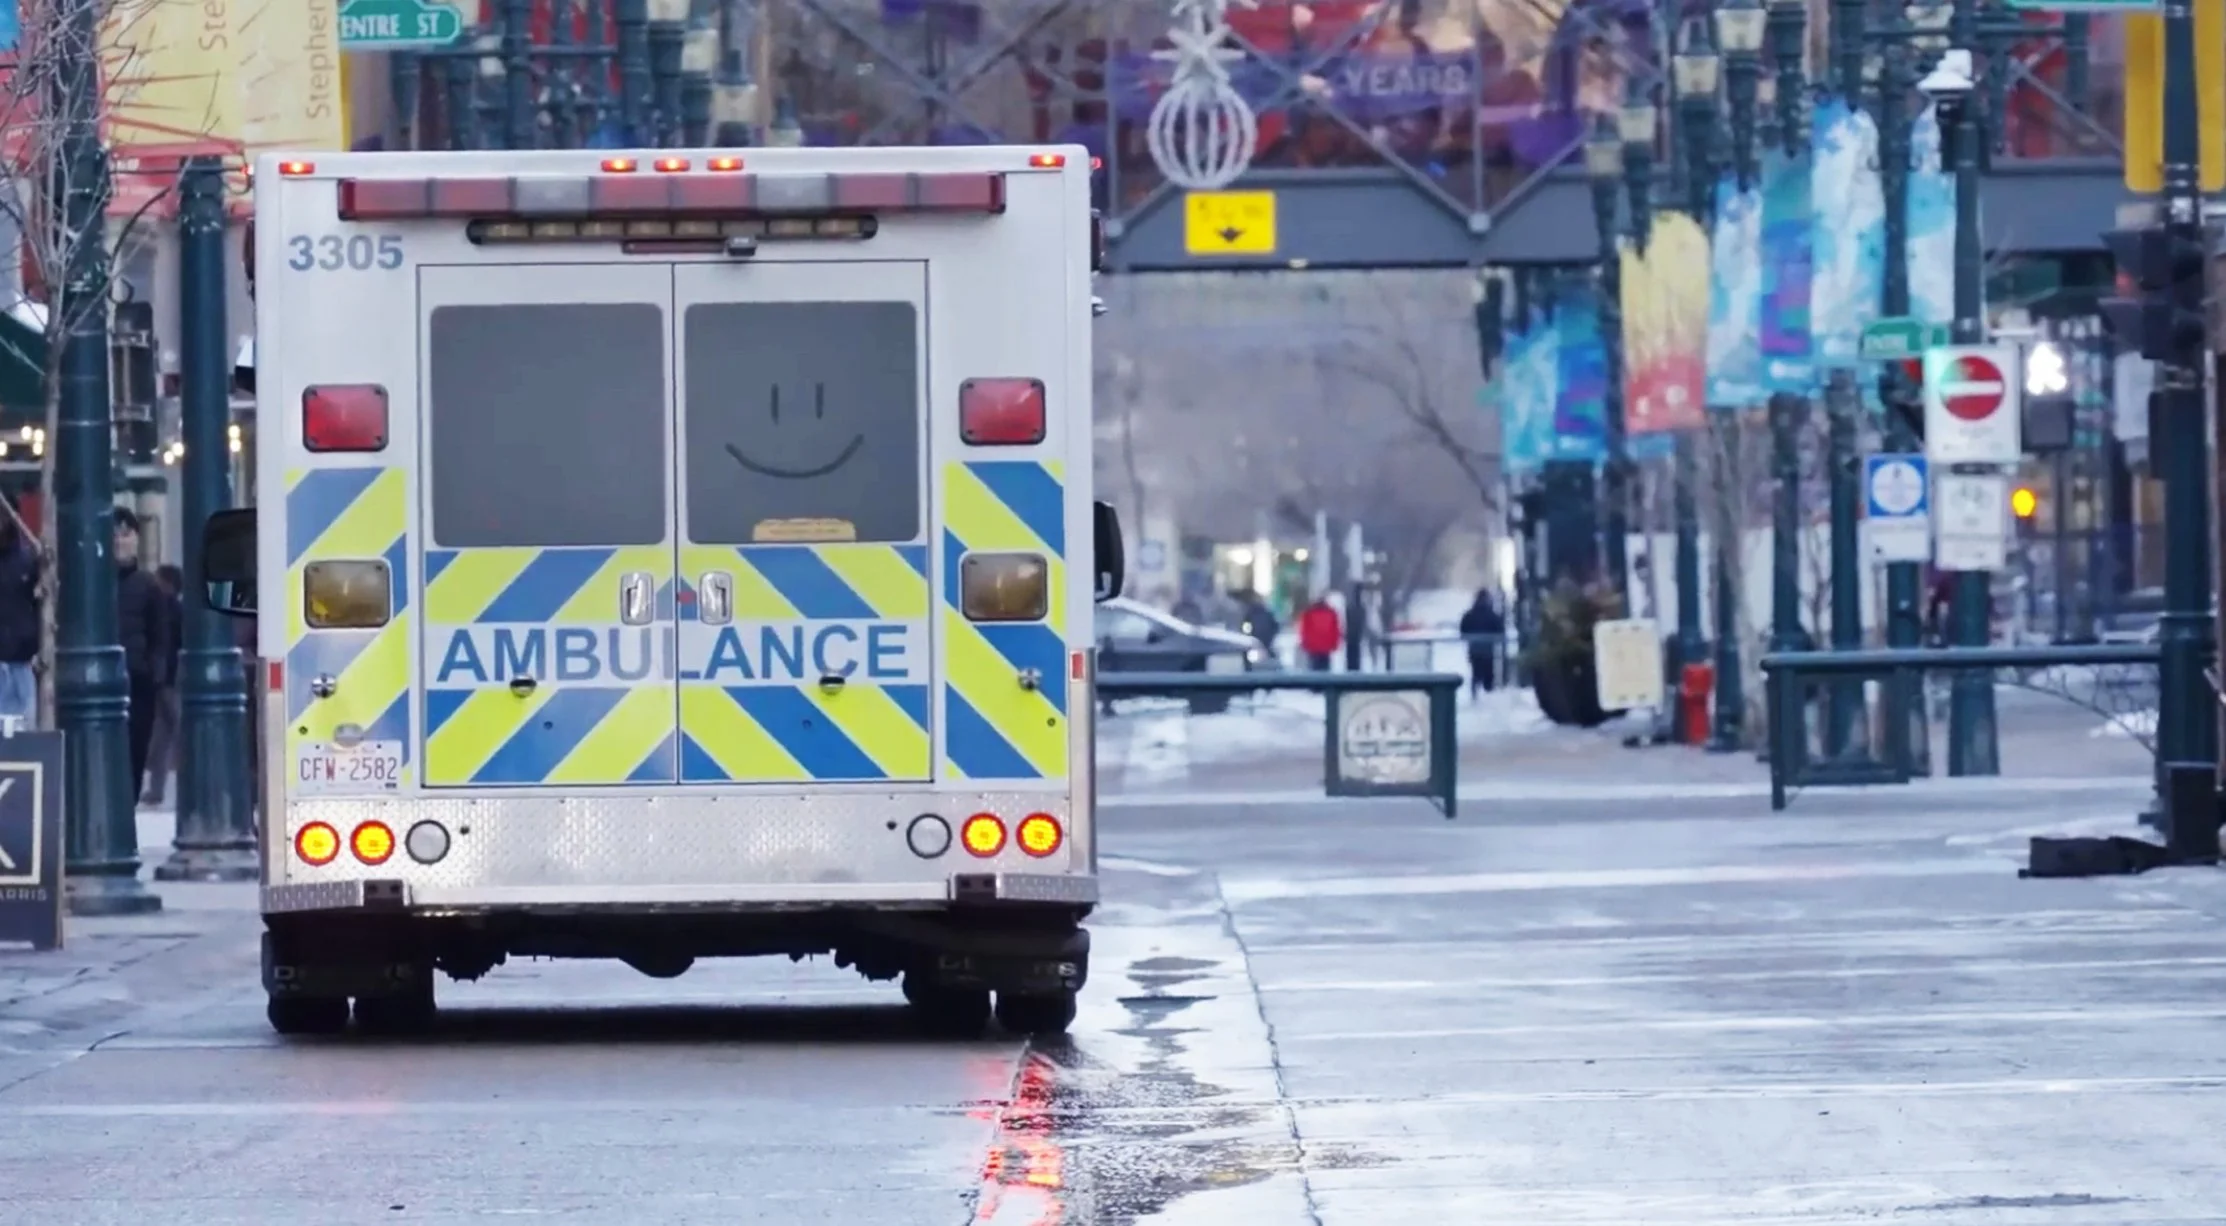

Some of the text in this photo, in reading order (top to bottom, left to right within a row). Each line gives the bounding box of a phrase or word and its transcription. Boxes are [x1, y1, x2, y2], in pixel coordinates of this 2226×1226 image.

[341, 12, 440, 38] ENTRE ST
[1344, 62, 1468, 96] YEARS
[288, 234, 404, 271] 3305
[436, 624, 909, 682] AMBULANCE
[300, 757, 398, 781] CFW-2582
